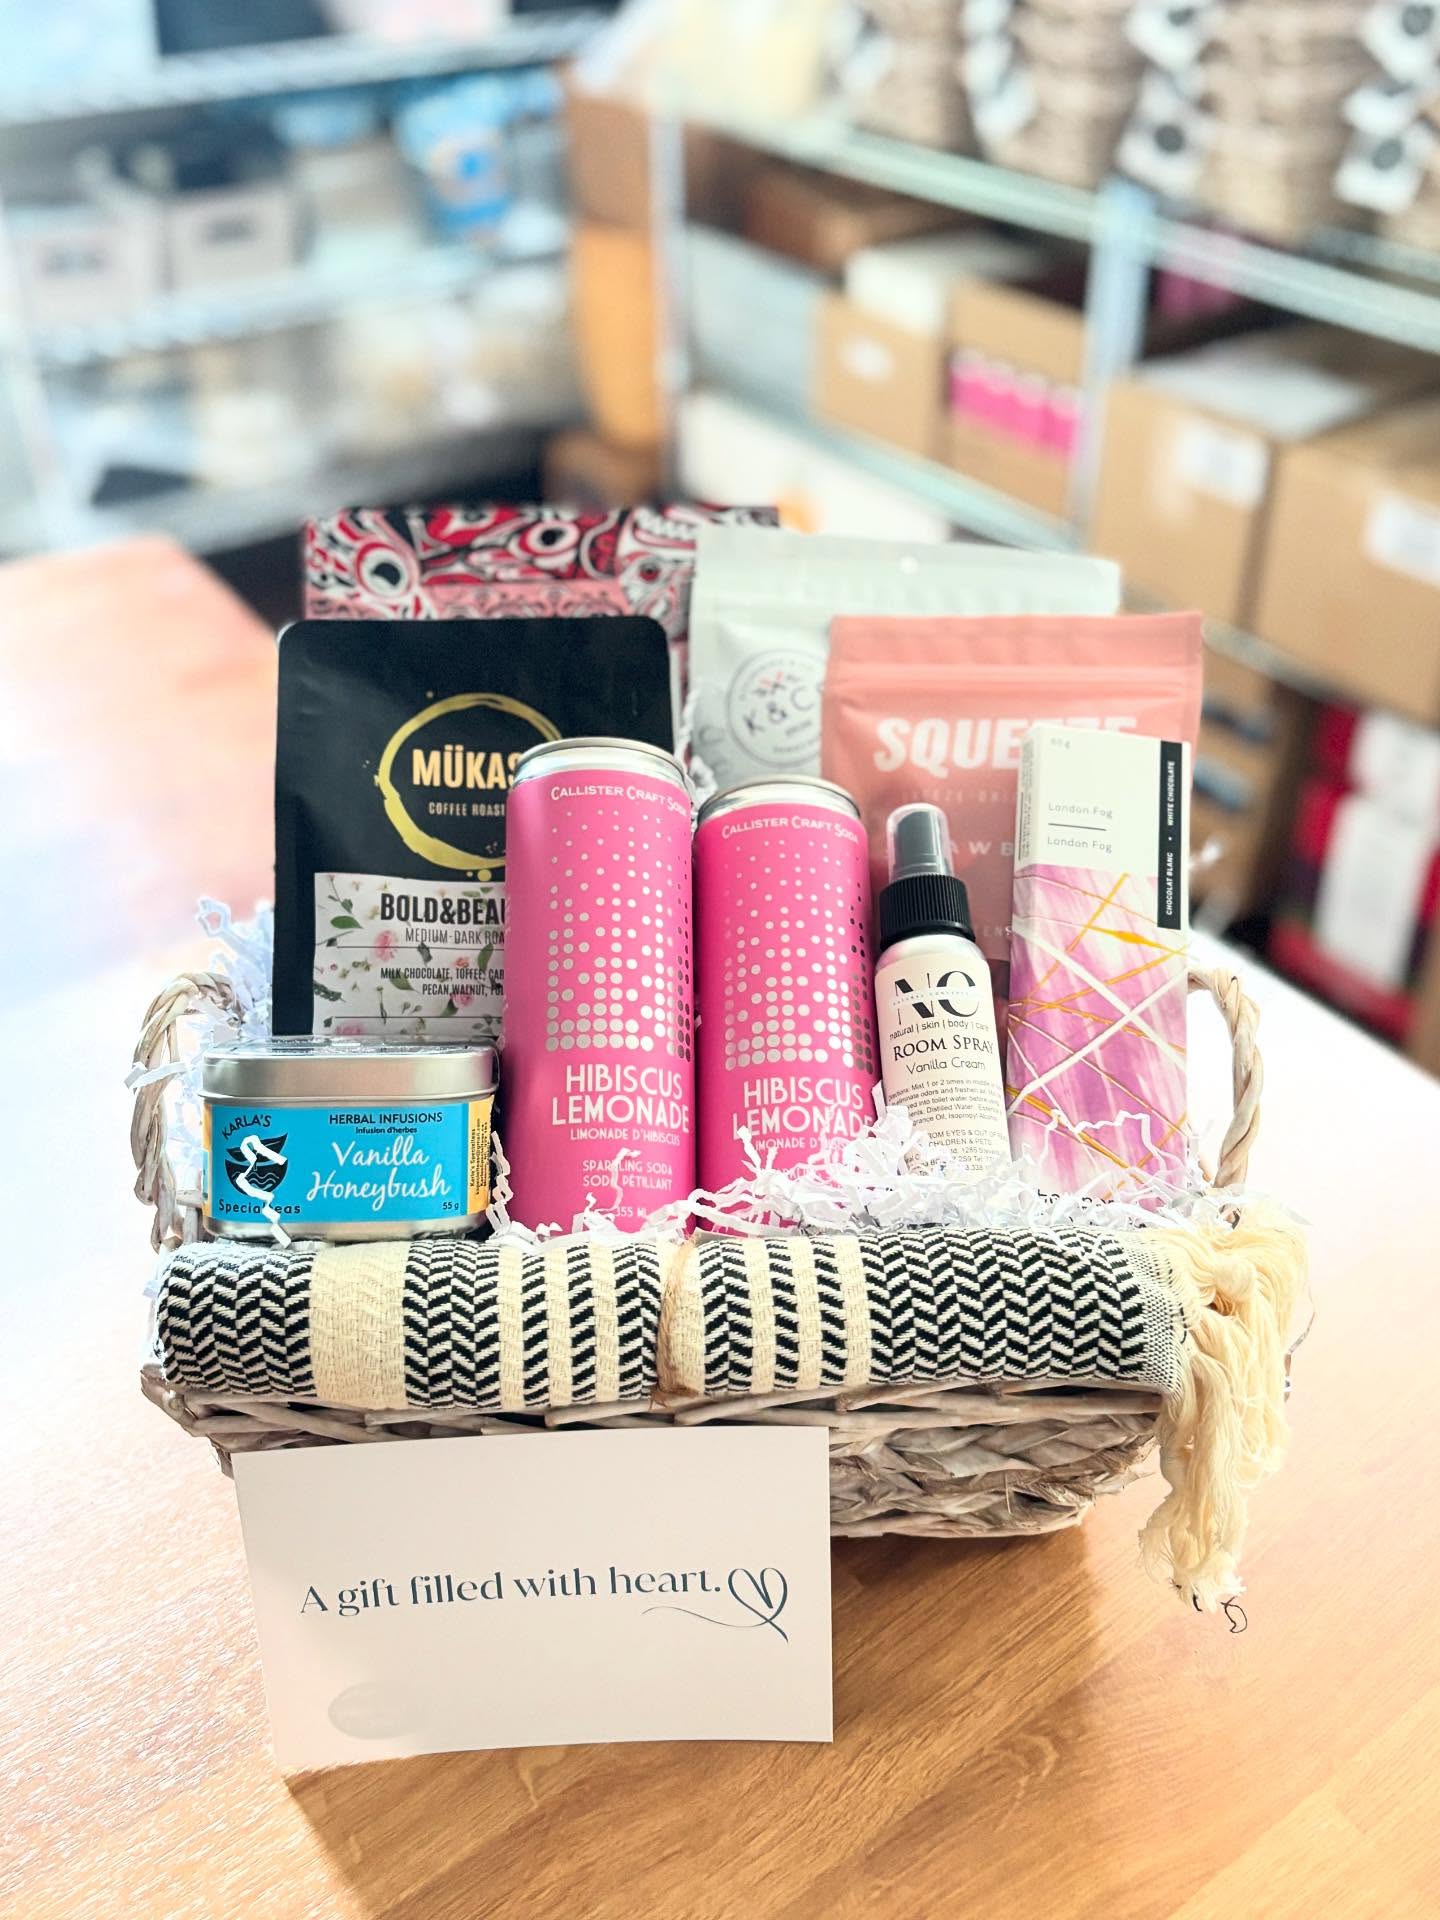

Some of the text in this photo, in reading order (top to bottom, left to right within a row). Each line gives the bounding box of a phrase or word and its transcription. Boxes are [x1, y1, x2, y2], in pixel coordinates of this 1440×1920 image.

[412, 744, 522, 789] MÜKAS
[1167, 761, 1175, 802] CHOCOLATE
[551, 785, 624, 800] CALLISTER
[627, 786, 665, 805] CRAFT
[429, 802, 467, 816] COFFEE
[1048, 803, 1113, 819] London Fog
[722, 816, 859, 844] CALLISTER CRAFT SODA
[1047, 836, 1113, 854] London Fog
[381, 968, 400, 979] MILK
[404, 968, 452, 981] CHOCOLATE,
[889, 1024, 914, 1040] natural
[922, 1020, 940, 1030] skin
[948, 1019, 968, 1030] body
[894, 1037, 947, 1061] ROOM
[906, 1057, 985, 1074] Vanilla Cream
[566, 1064, 683, 1100] HIBISCUS
[744, 1077, 864, 1110] HIBISCUS
[329, 1112, 443, 1125] HERBAL INFUSIONS
[552, 1094, 689, 1133] LEMONADE
[222, 1114, 272, 1140] KARLA'S
[387, 1126, 417, 1134] d'herbes
[570, 1128, 680, 1146] LIMONADE D'HIBISCUS
[332, 1135, 430, 1167] Vanilla
[755, 1137, 806, 1151] IMONADE
[583, 1160, 672, 1176] SPARLING SODA
[307, 1164, 450, 1211] Honeybush
[583, 1174, 672, 1191] SOD PÉTILLANT
[442, 1202, 459, 1211] 55 g
[300, 1566, 721, 1616] A gift filled with heart.
